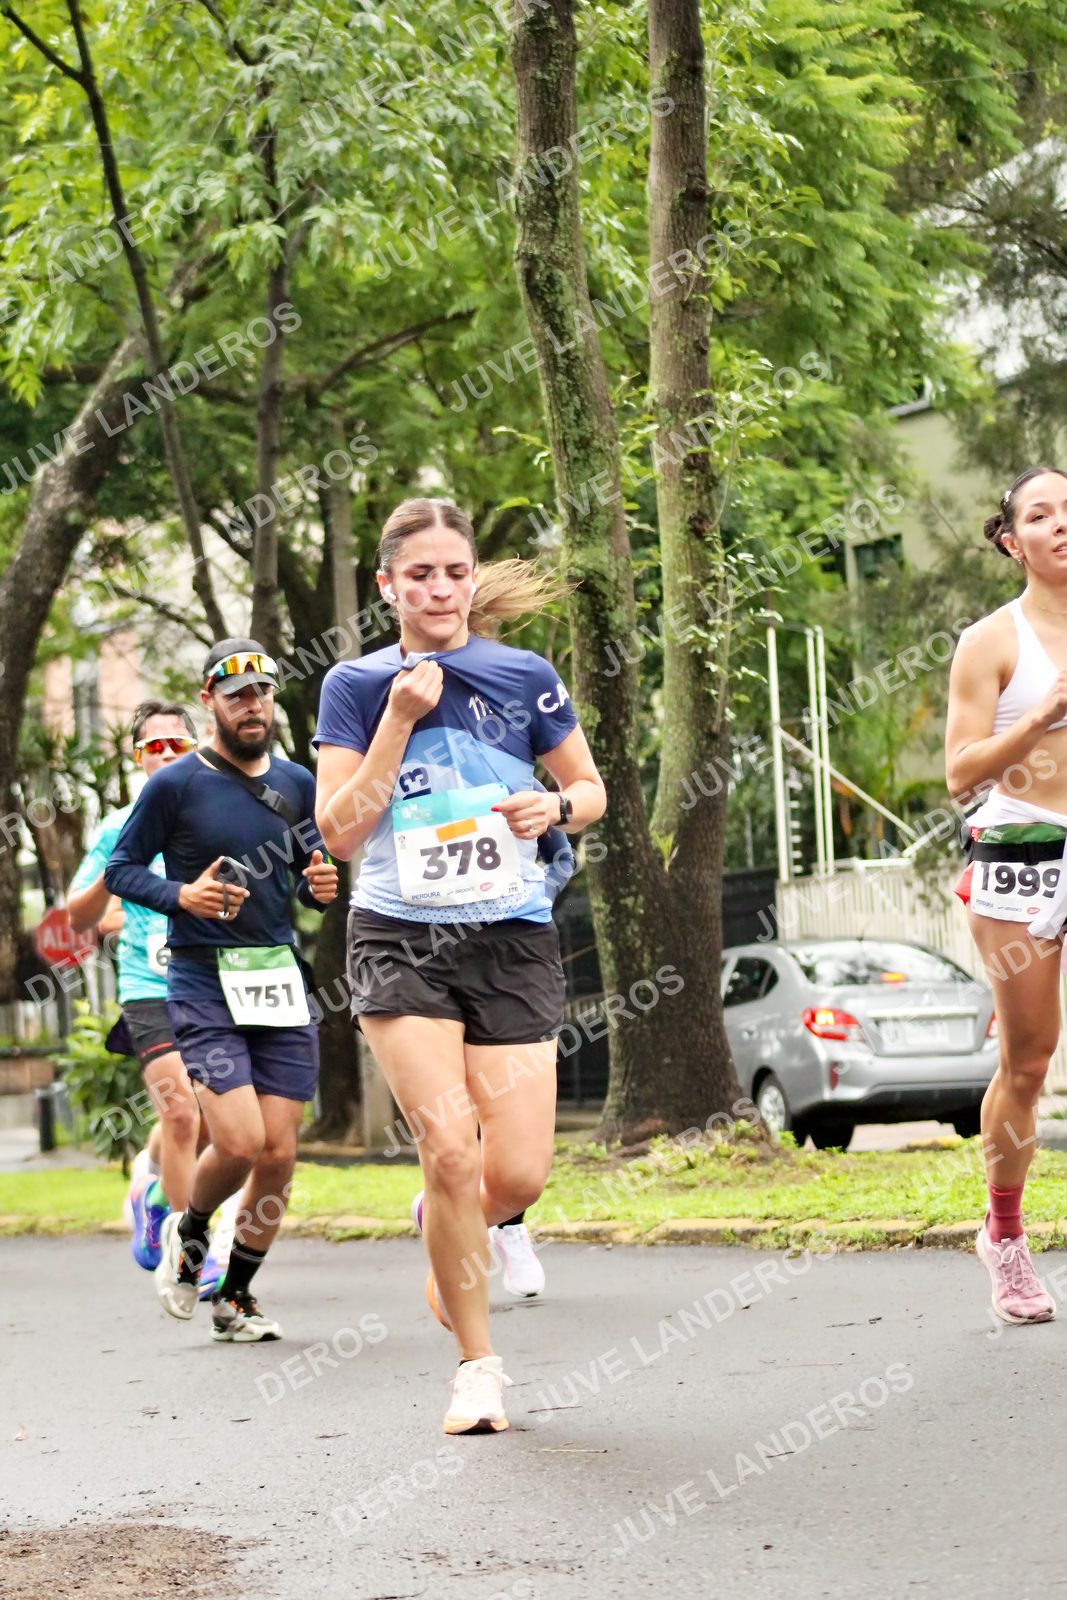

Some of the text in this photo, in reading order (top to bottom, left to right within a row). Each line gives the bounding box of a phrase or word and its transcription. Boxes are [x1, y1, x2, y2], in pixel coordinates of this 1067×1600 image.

[420, 836, 502, 880] 378
[981, 862, 1061, 898] 1999
[231, 983, 294, 1008] 1751
